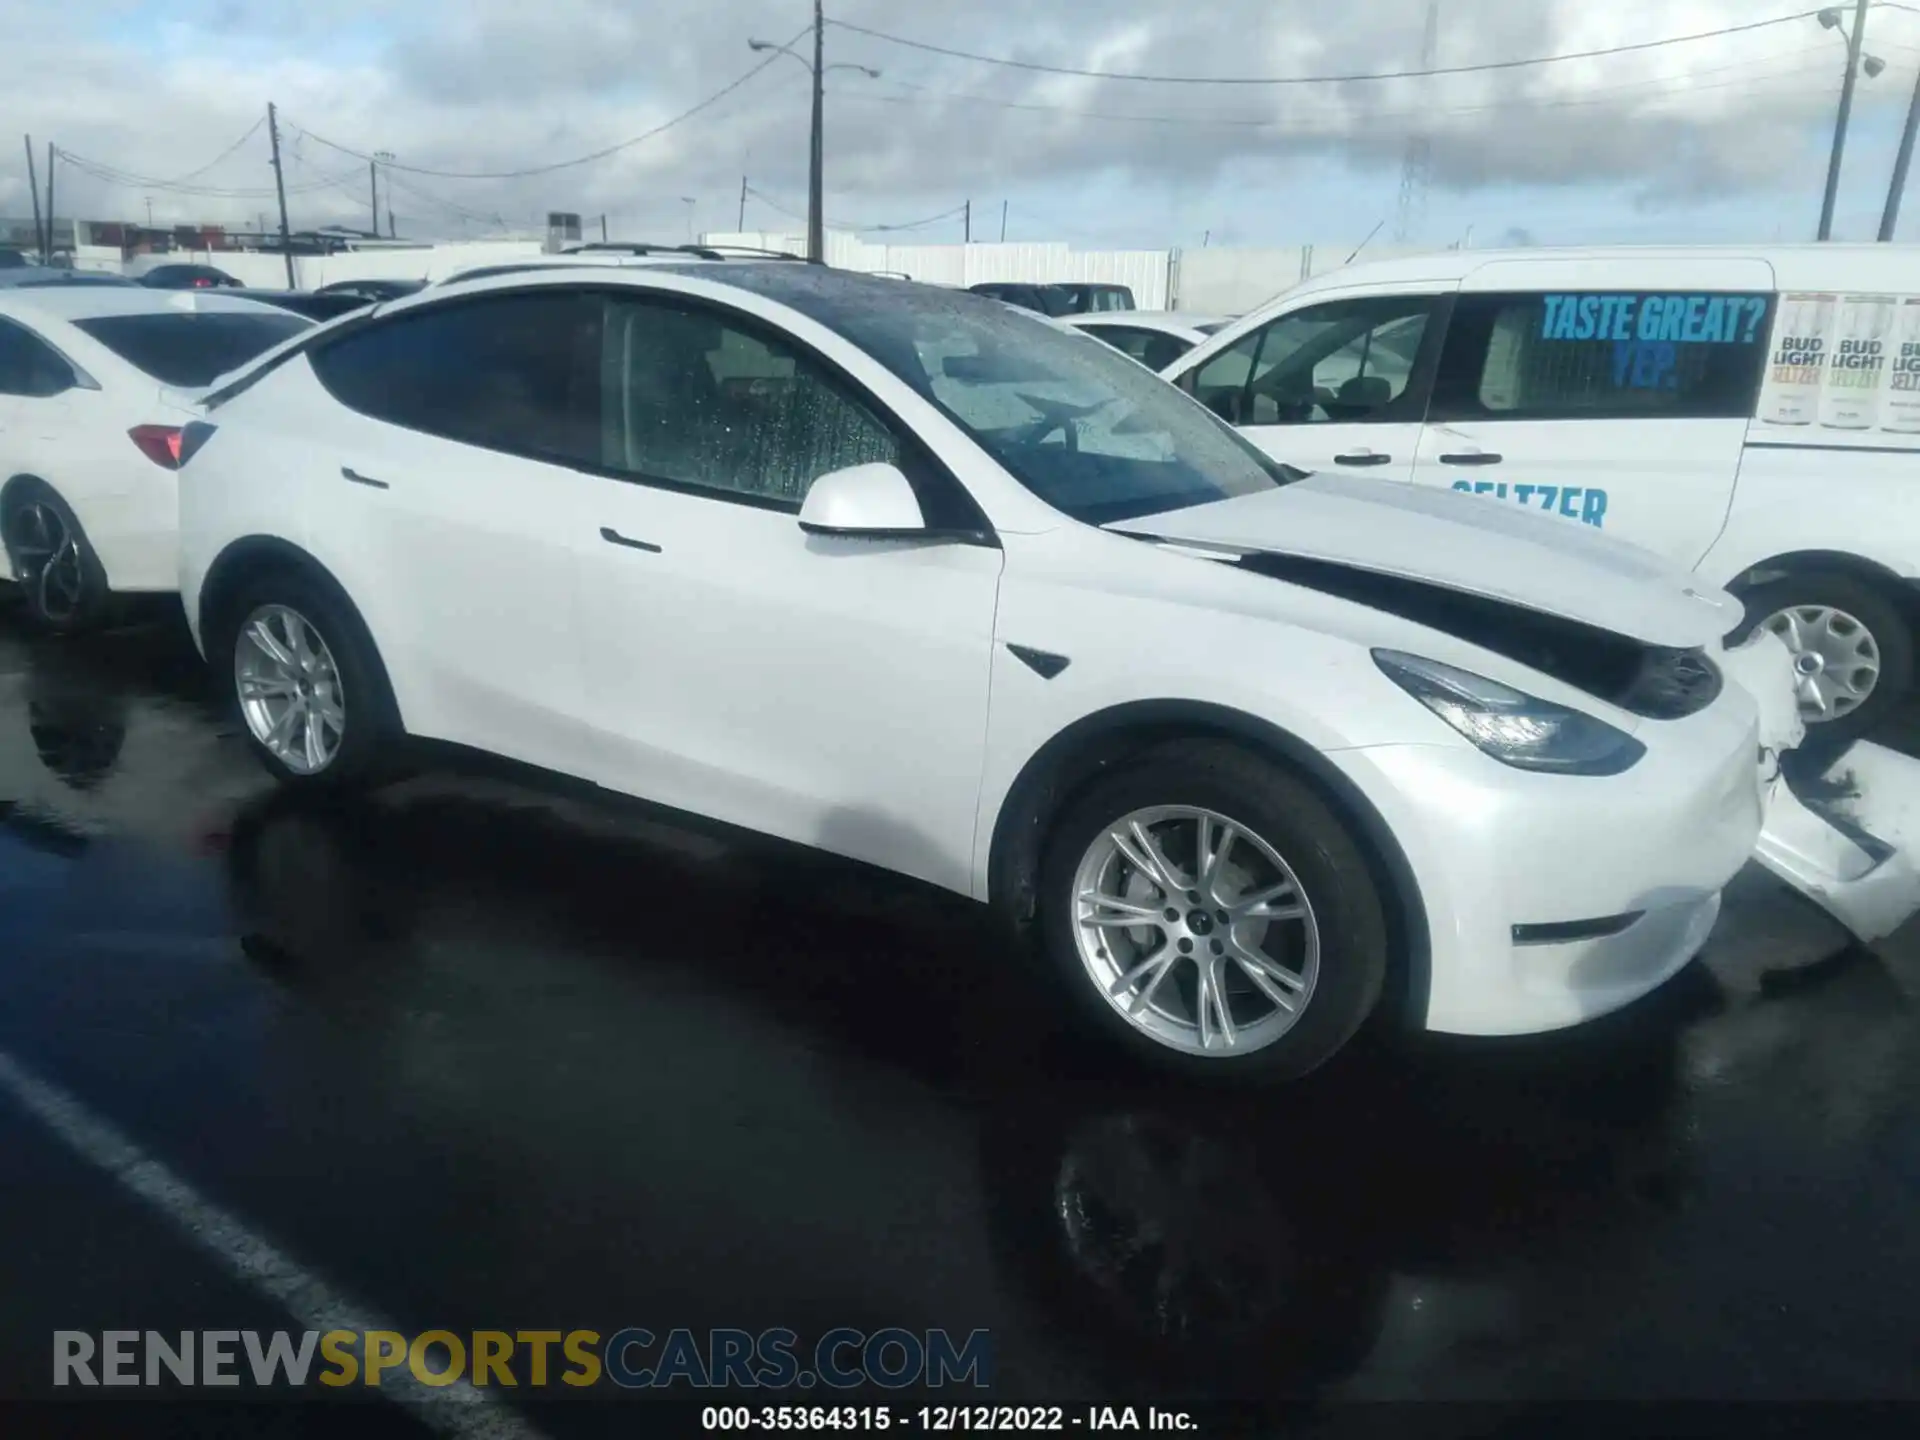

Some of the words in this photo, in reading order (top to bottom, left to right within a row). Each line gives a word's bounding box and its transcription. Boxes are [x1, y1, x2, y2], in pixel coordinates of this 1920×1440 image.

[1542, 295, 1637, 340] TASTE
[1636, 296, 1767, 343] GREAT?
[1781, 337, 1823, 351] BUD
[1839, 340, 1883, 354] BUD
[1773, 351, 1826, 367] LIGHT
[1830, 354, 1885, 369] LIGHT
[1892, 357, 1920, 372] LIG
